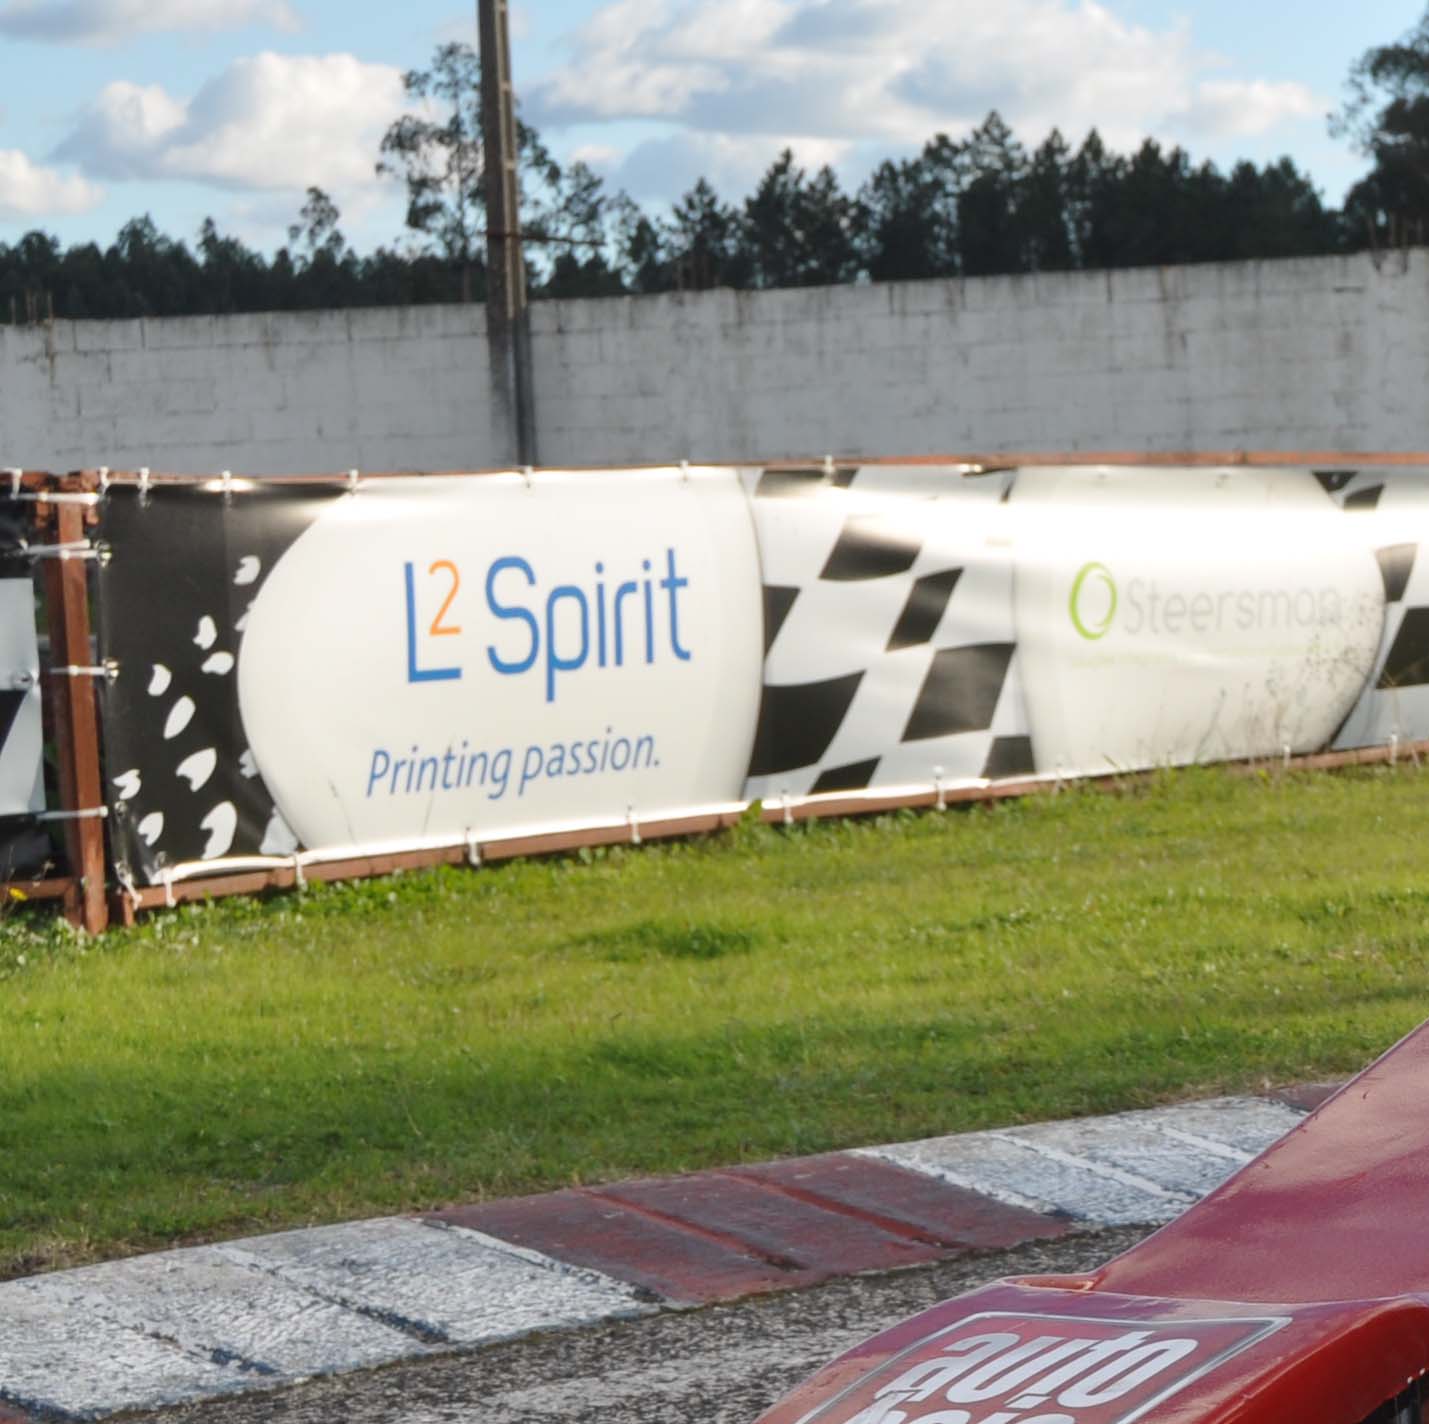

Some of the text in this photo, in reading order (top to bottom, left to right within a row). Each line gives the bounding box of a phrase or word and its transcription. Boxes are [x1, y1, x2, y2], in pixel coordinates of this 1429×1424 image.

[486, 548, 692, 702] Spirit
[365, 725, 662, 801] Printing passion.
[875, 1330, 1199, 1409] auto
